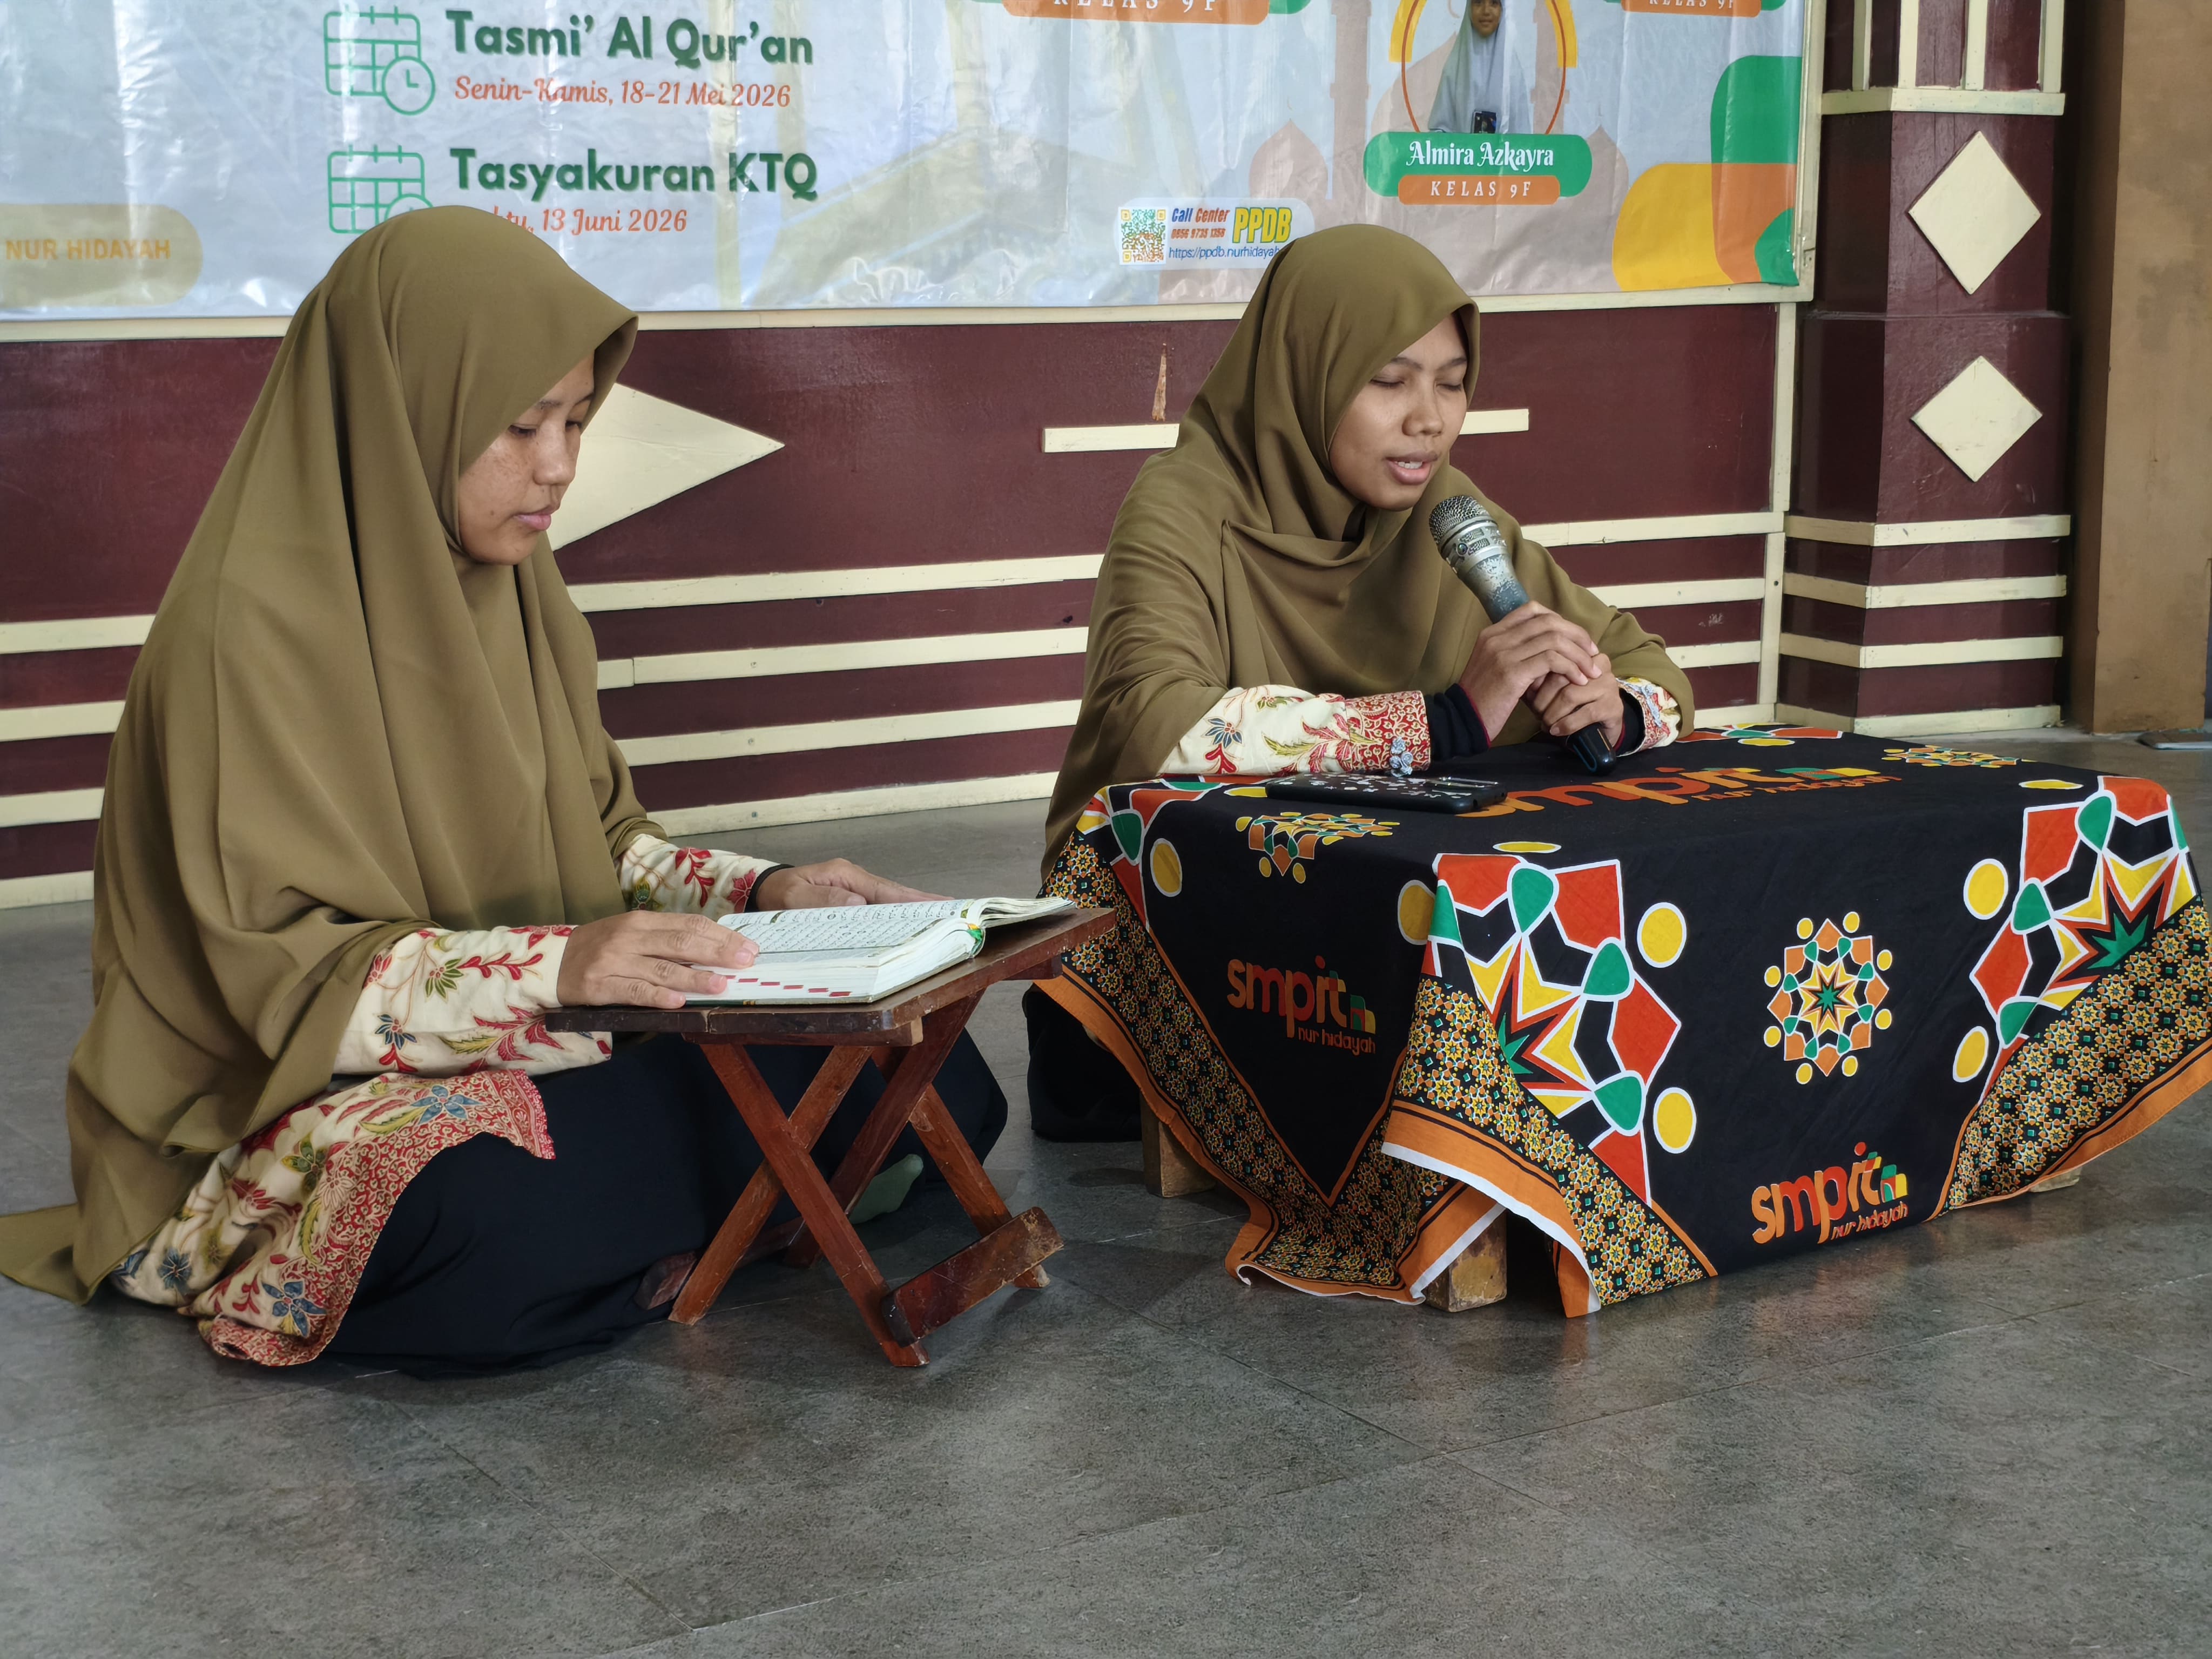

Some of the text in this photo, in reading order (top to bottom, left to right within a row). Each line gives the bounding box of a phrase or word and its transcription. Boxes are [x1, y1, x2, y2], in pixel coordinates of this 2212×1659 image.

[446, 10, 814, 69] Tasmi’ Al Qur’an
[454, 76, 791, 107] Senin-Kamis, 18-21 Mei 2026
[1406, 140, 1554, 172] Almira Azkayra
[450, 148, 818, 202] Tasyakuran KTQ
[1431, 181, 1531, 198] KELAS 9F
[543, 210, 565, 230] 13
[572, 210, 623, 235] Juni
[629, 210, 687, 232] 2026
[1171, 207, 1230, 223] Call Center
[1232, 207, 1292, 244] PPDB
[6, 239, 171, 260] NUR HIDAYAH
[1227, 955, 1347, 1038] smpit
[1298, 1027, 1375, 1056] nur hidayah
[1751, 1142, 1882, 1244] smpit
[1830, 1201, 1908, 1240] nur hidayah
